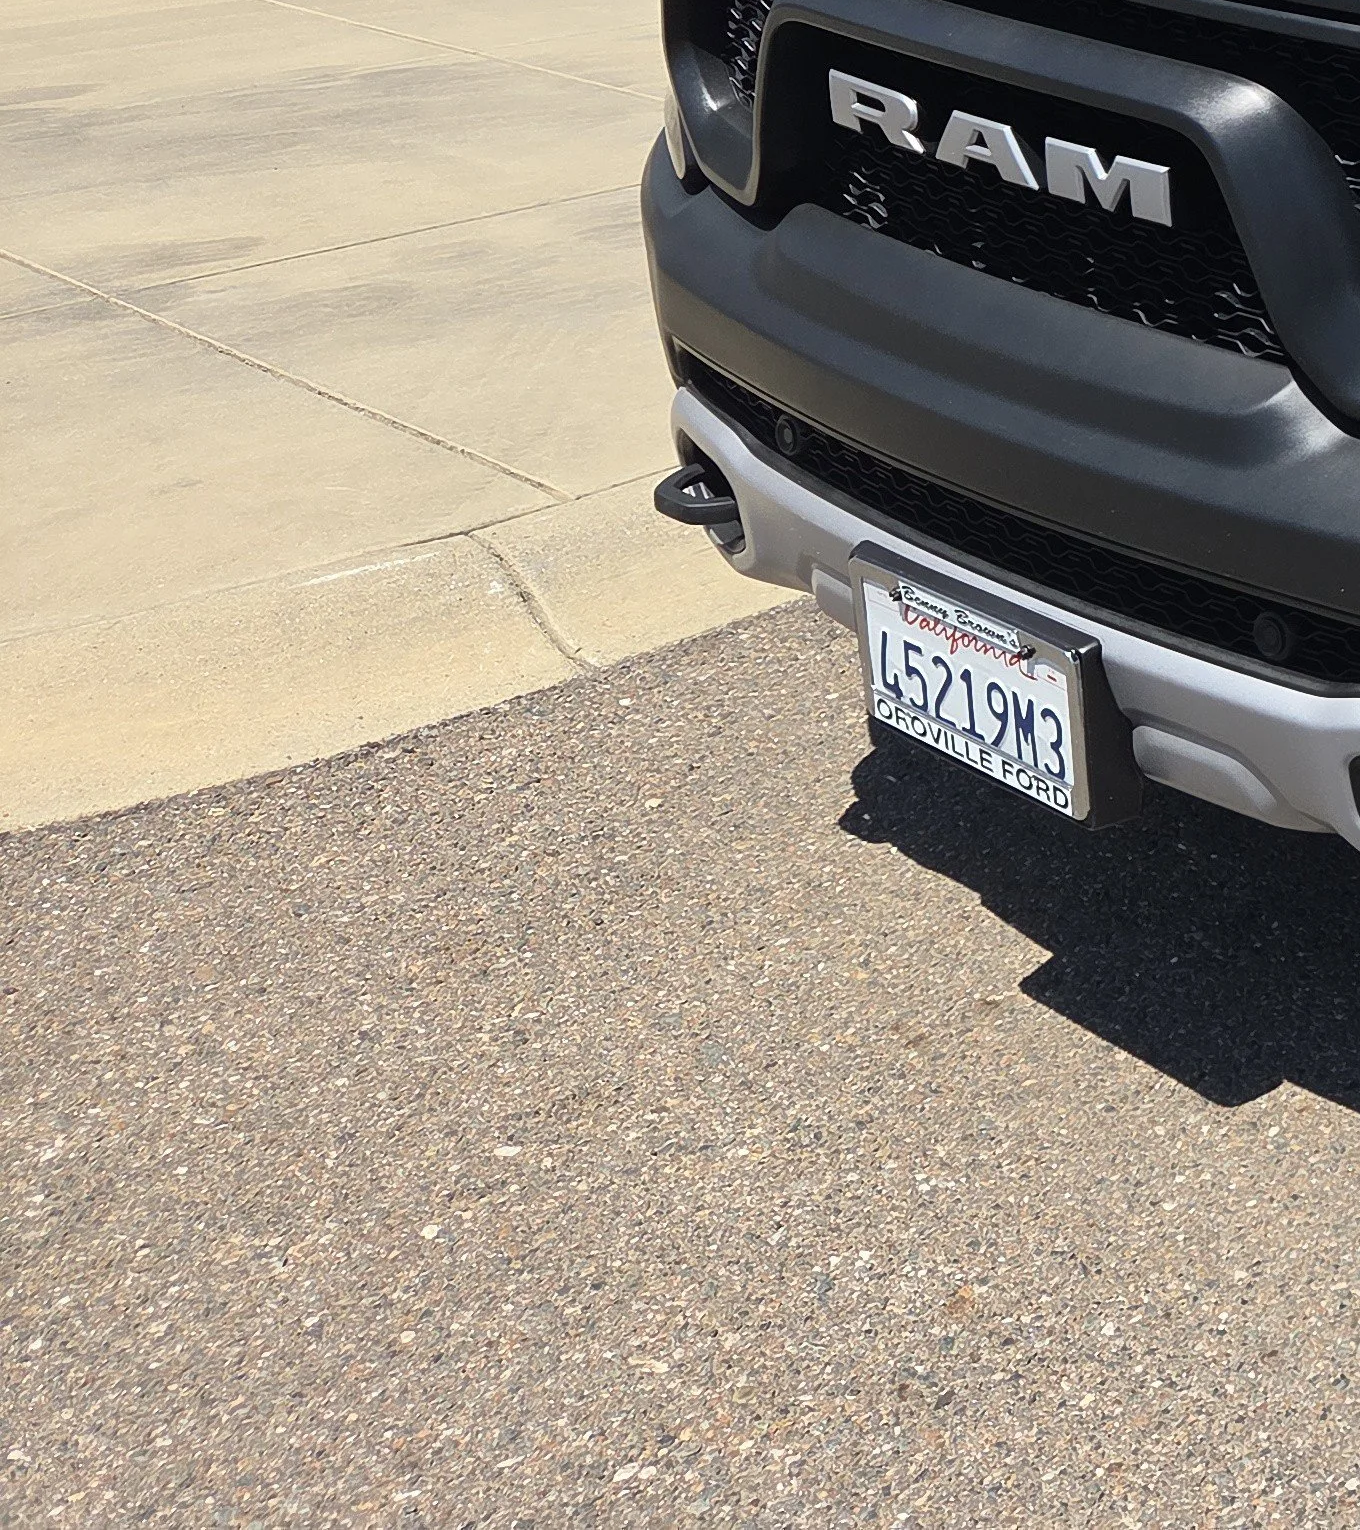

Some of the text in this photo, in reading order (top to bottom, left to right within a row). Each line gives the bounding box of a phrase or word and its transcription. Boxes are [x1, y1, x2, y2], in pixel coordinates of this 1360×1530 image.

[829, 69, 1172, 227] RAM
[901, 585, 1018, 649] Benny Brown's
[876, 698, 1069, 810] OROVILLE FORD
[880, 630, 1067, 781] 45219M3
